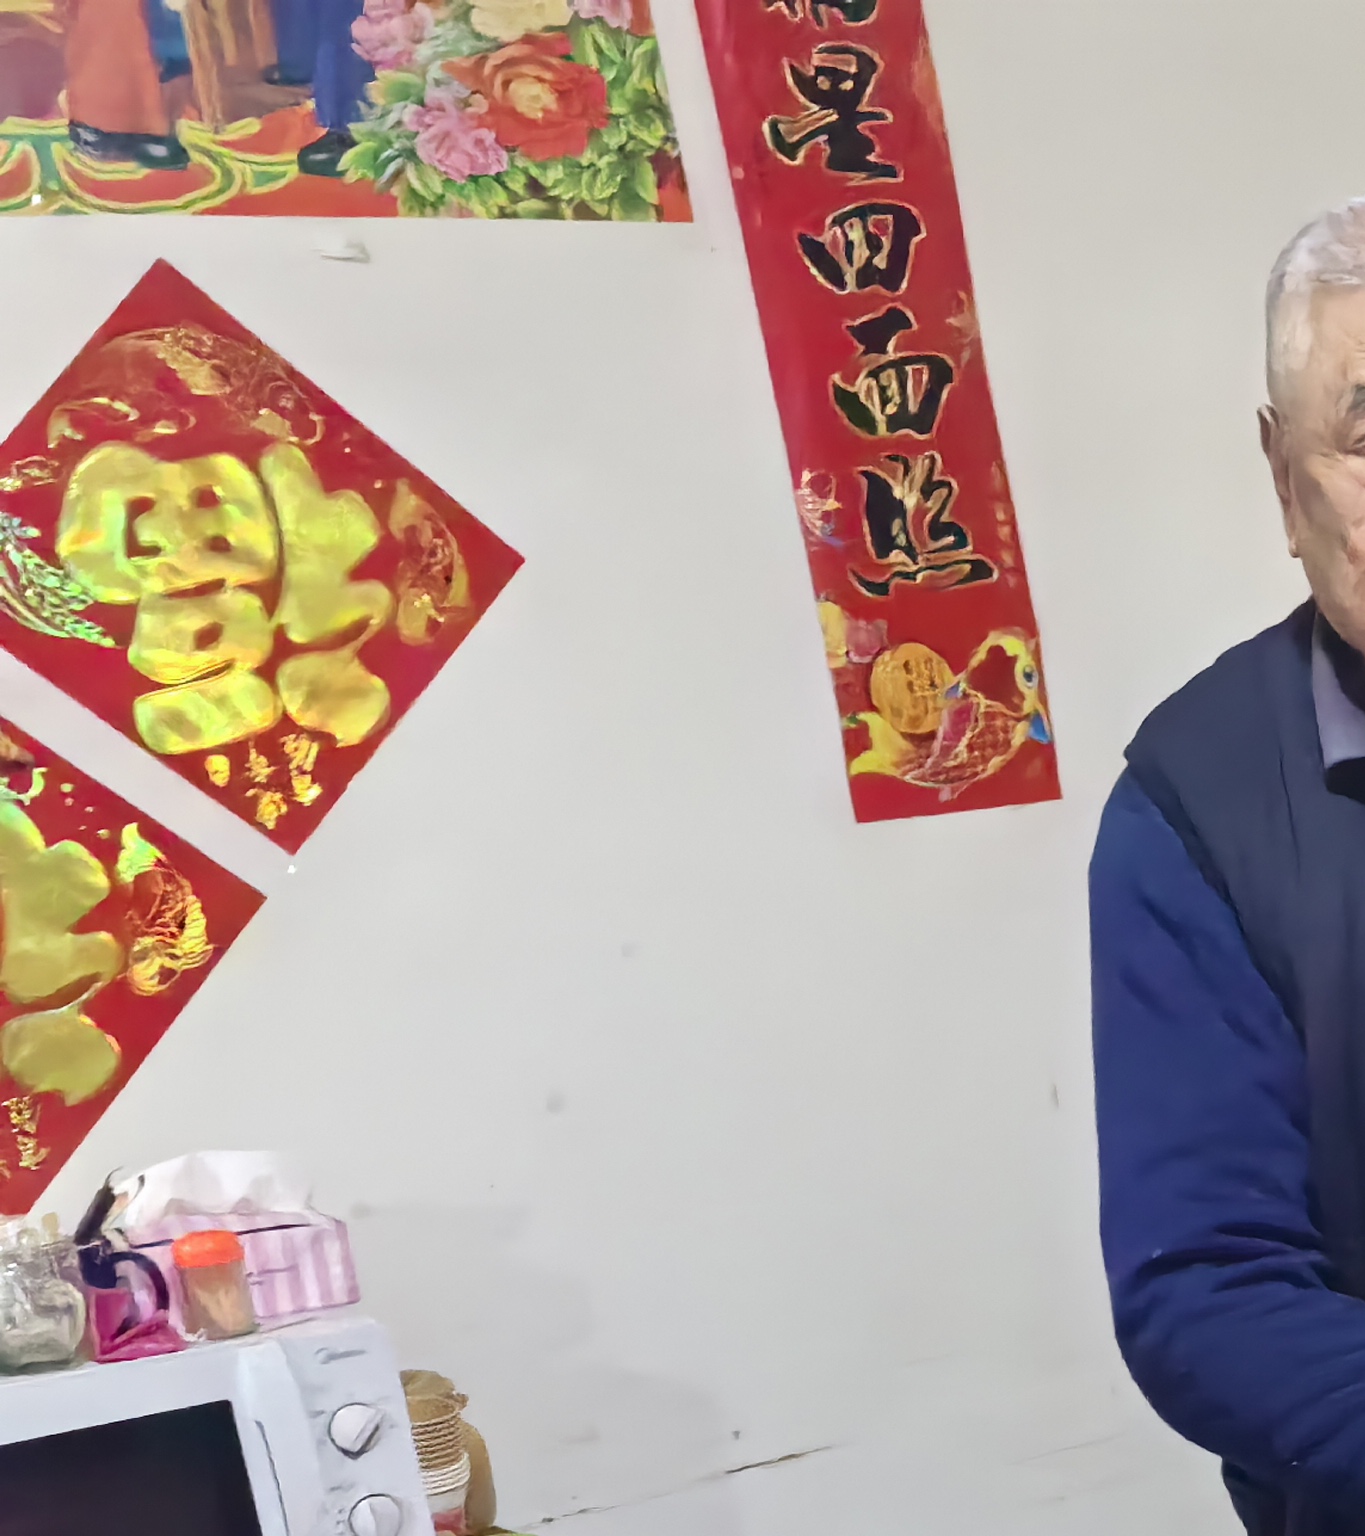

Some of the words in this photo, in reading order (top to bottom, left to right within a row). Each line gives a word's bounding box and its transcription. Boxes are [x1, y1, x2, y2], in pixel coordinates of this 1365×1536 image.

[762, 0, 998, 599] 星四面照
[57, 440, 394, 755] 福
